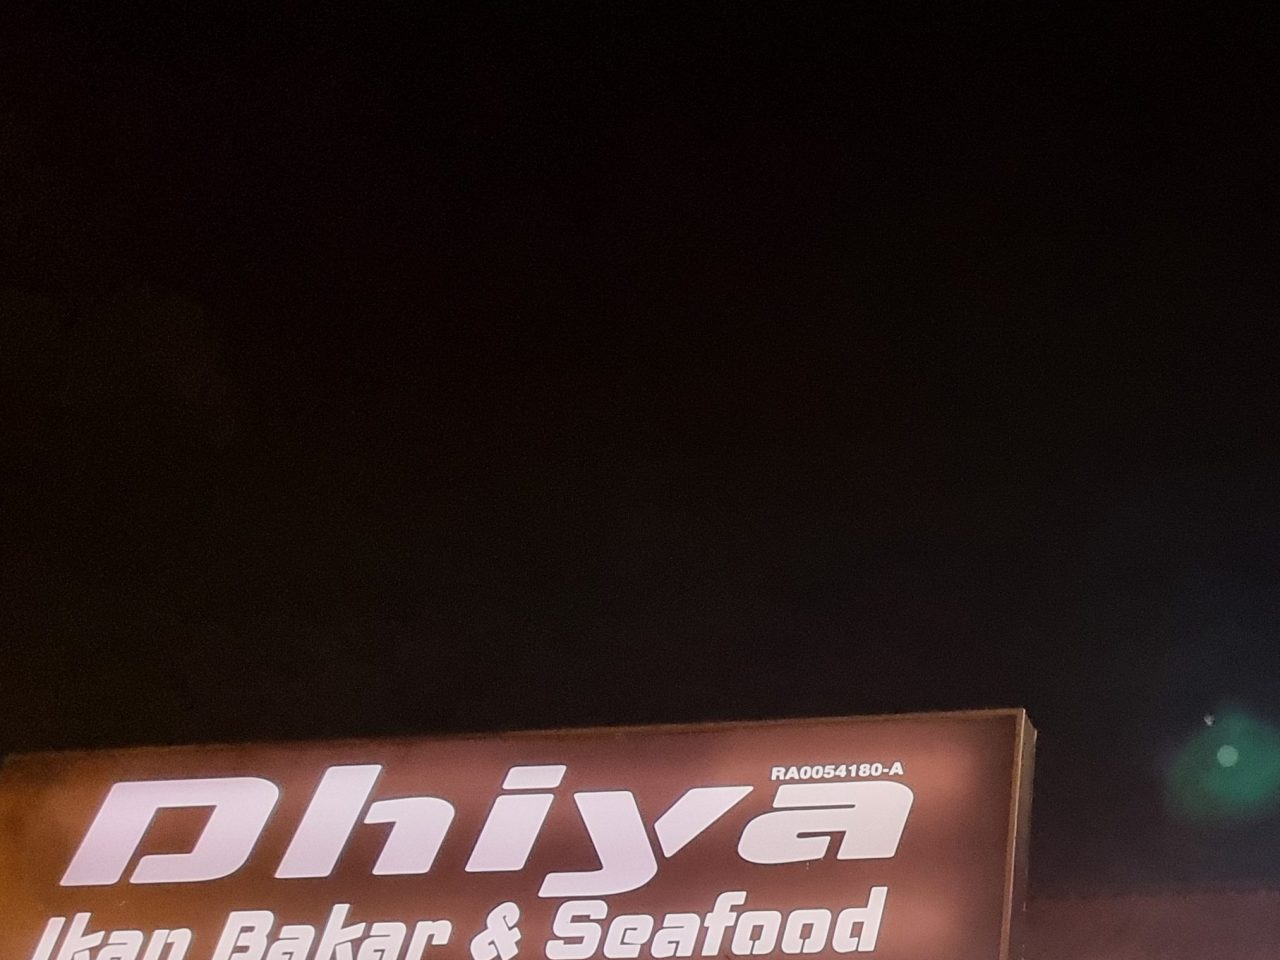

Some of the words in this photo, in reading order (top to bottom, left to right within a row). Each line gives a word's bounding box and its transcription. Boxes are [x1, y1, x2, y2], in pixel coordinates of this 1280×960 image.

[771, 761, 904, 780] RA0054180-A
[59, 764, 915, 898] Dhiya
[545, 887, 887, 960] Seafood
